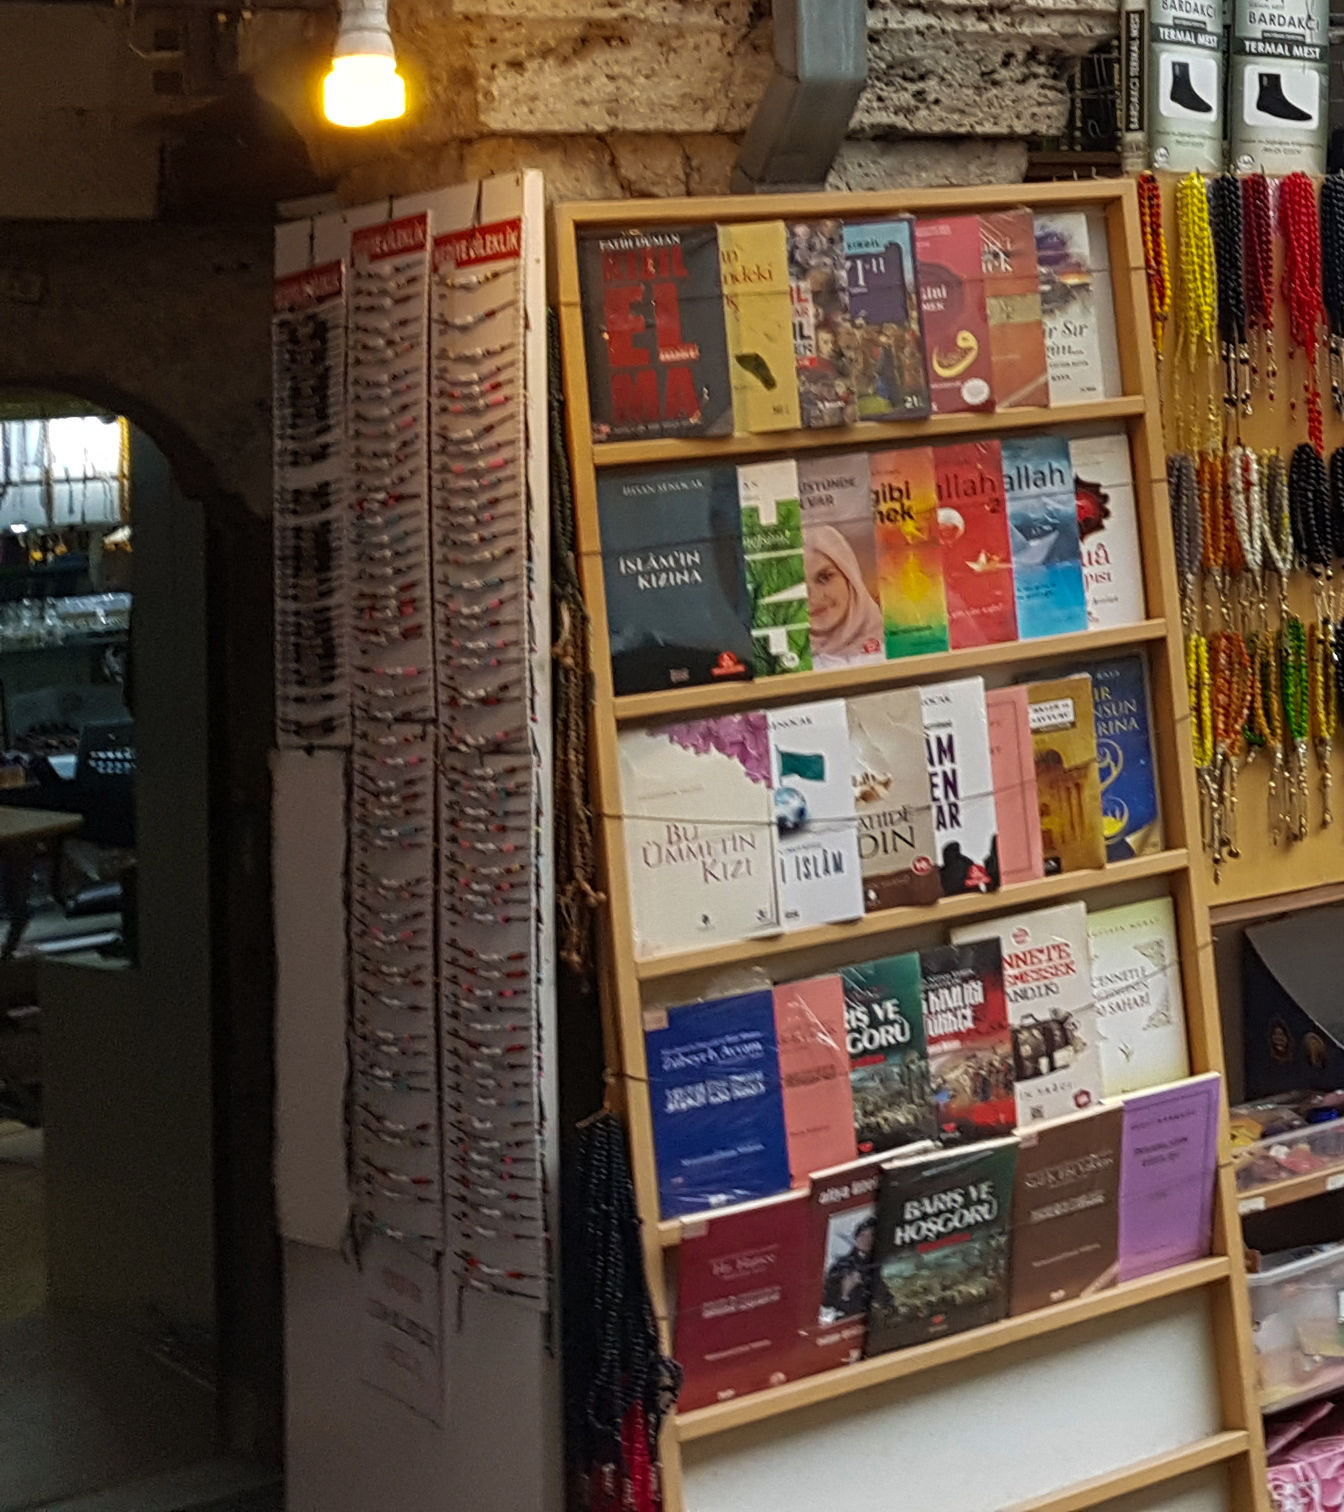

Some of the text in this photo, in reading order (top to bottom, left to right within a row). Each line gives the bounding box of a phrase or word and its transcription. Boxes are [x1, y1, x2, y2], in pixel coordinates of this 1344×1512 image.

[1158, 27, 1218, 48] TERMAL MEST
[1244, 41, 1321, 59] TERMAL MEST
[604, 282, 700, 366] EL
[874, 997, 901, 1020] VE
